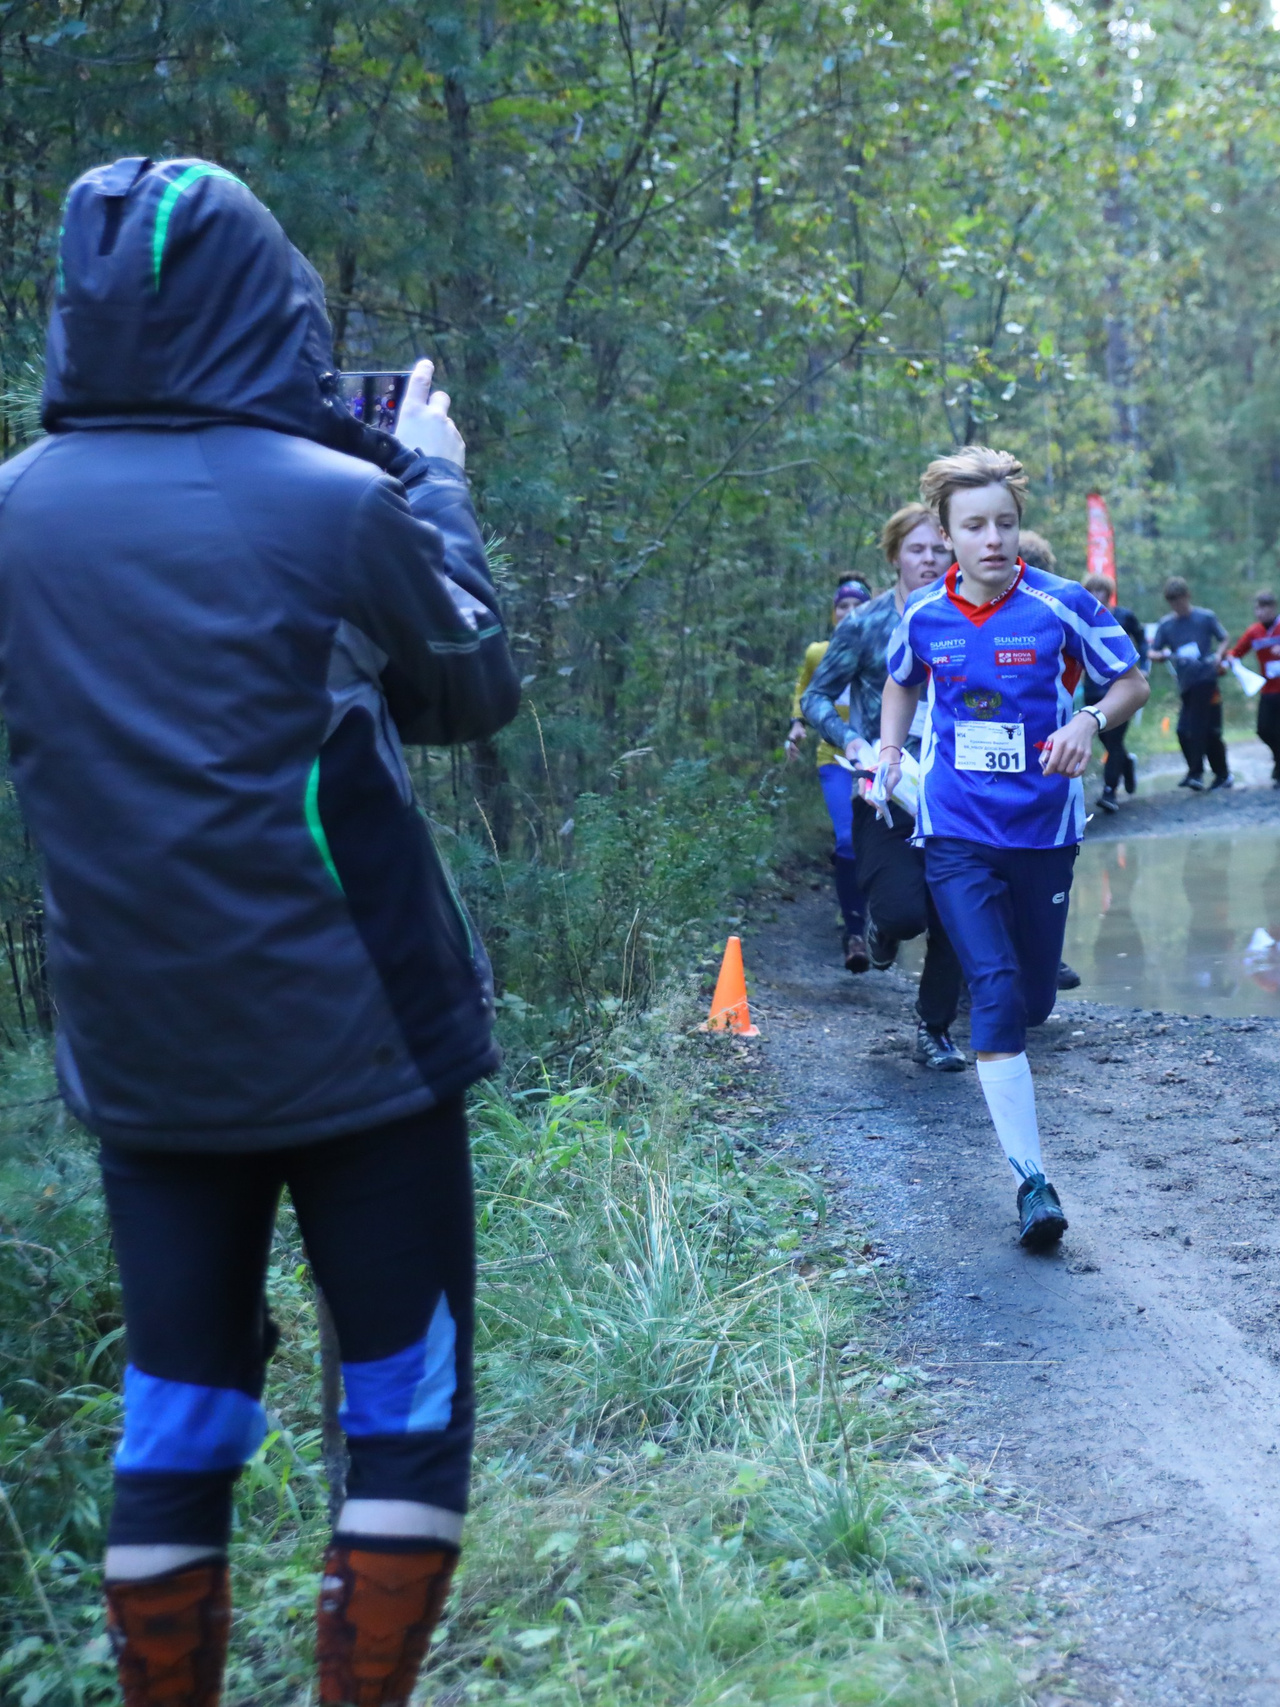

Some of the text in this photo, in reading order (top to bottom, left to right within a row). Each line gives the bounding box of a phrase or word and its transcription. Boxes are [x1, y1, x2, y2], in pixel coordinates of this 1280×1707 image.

[930, 638, 966, 648] SUUNTO
[993, 636, 1036, 644] SUUNTO
[985, 752, 1020, 770] 301
